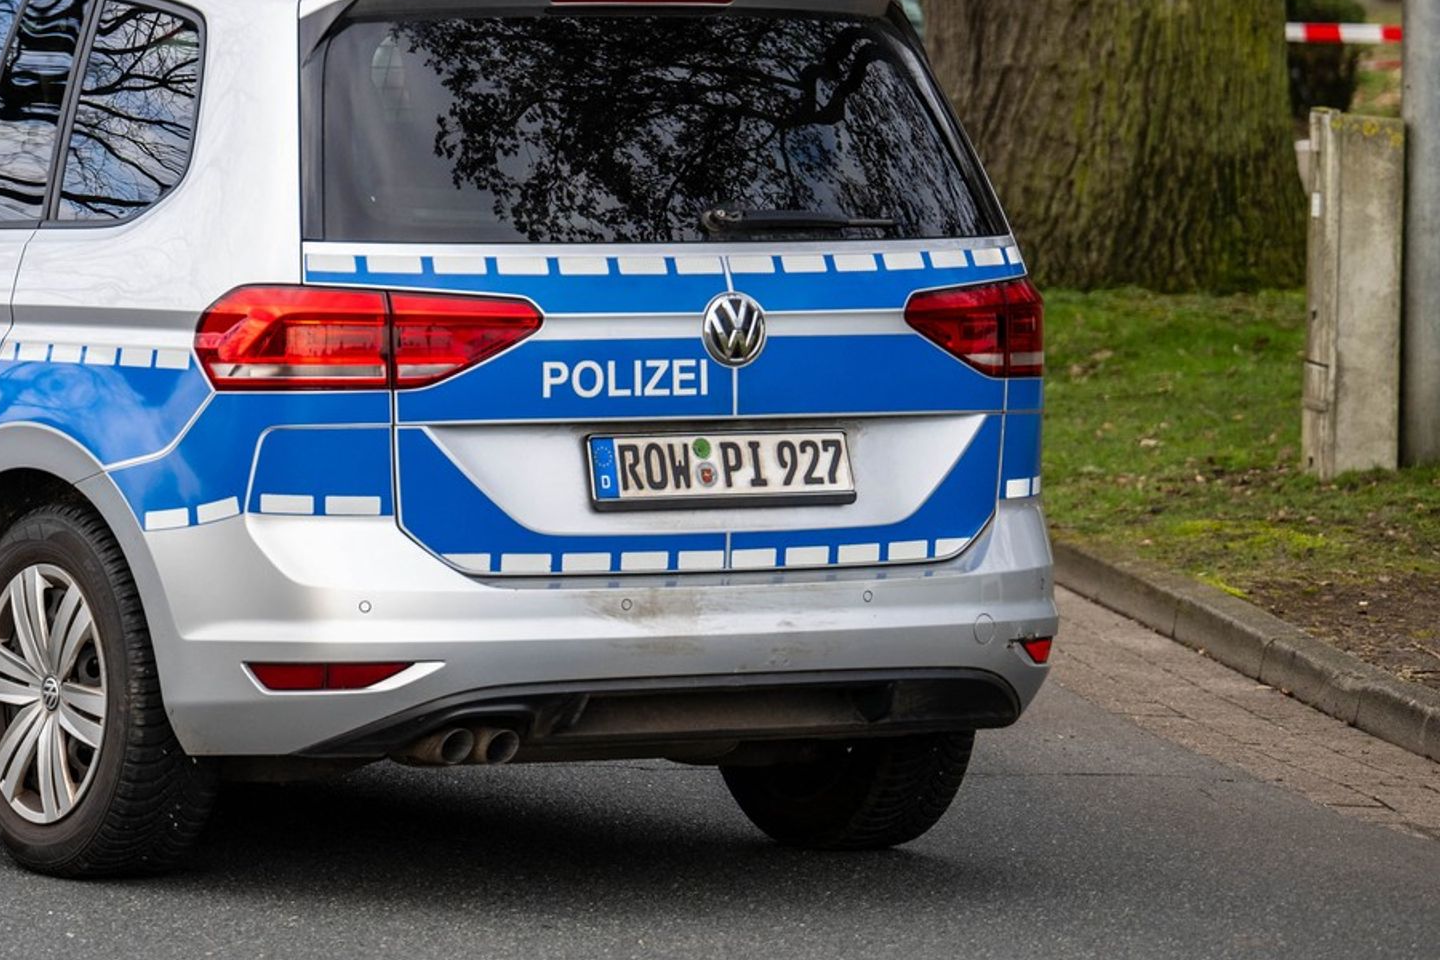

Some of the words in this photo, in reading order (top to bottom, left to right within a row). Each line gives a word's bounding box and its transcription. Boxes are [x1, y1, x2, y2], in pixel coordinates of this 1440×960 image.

[542, 359, 708, 398] POLIZEI
[601, 475, 611, 489] D
[617, 442, 691, 490] ROW
[719, 441, 768, 487] PI
[776, 439, 843, 486] 927
